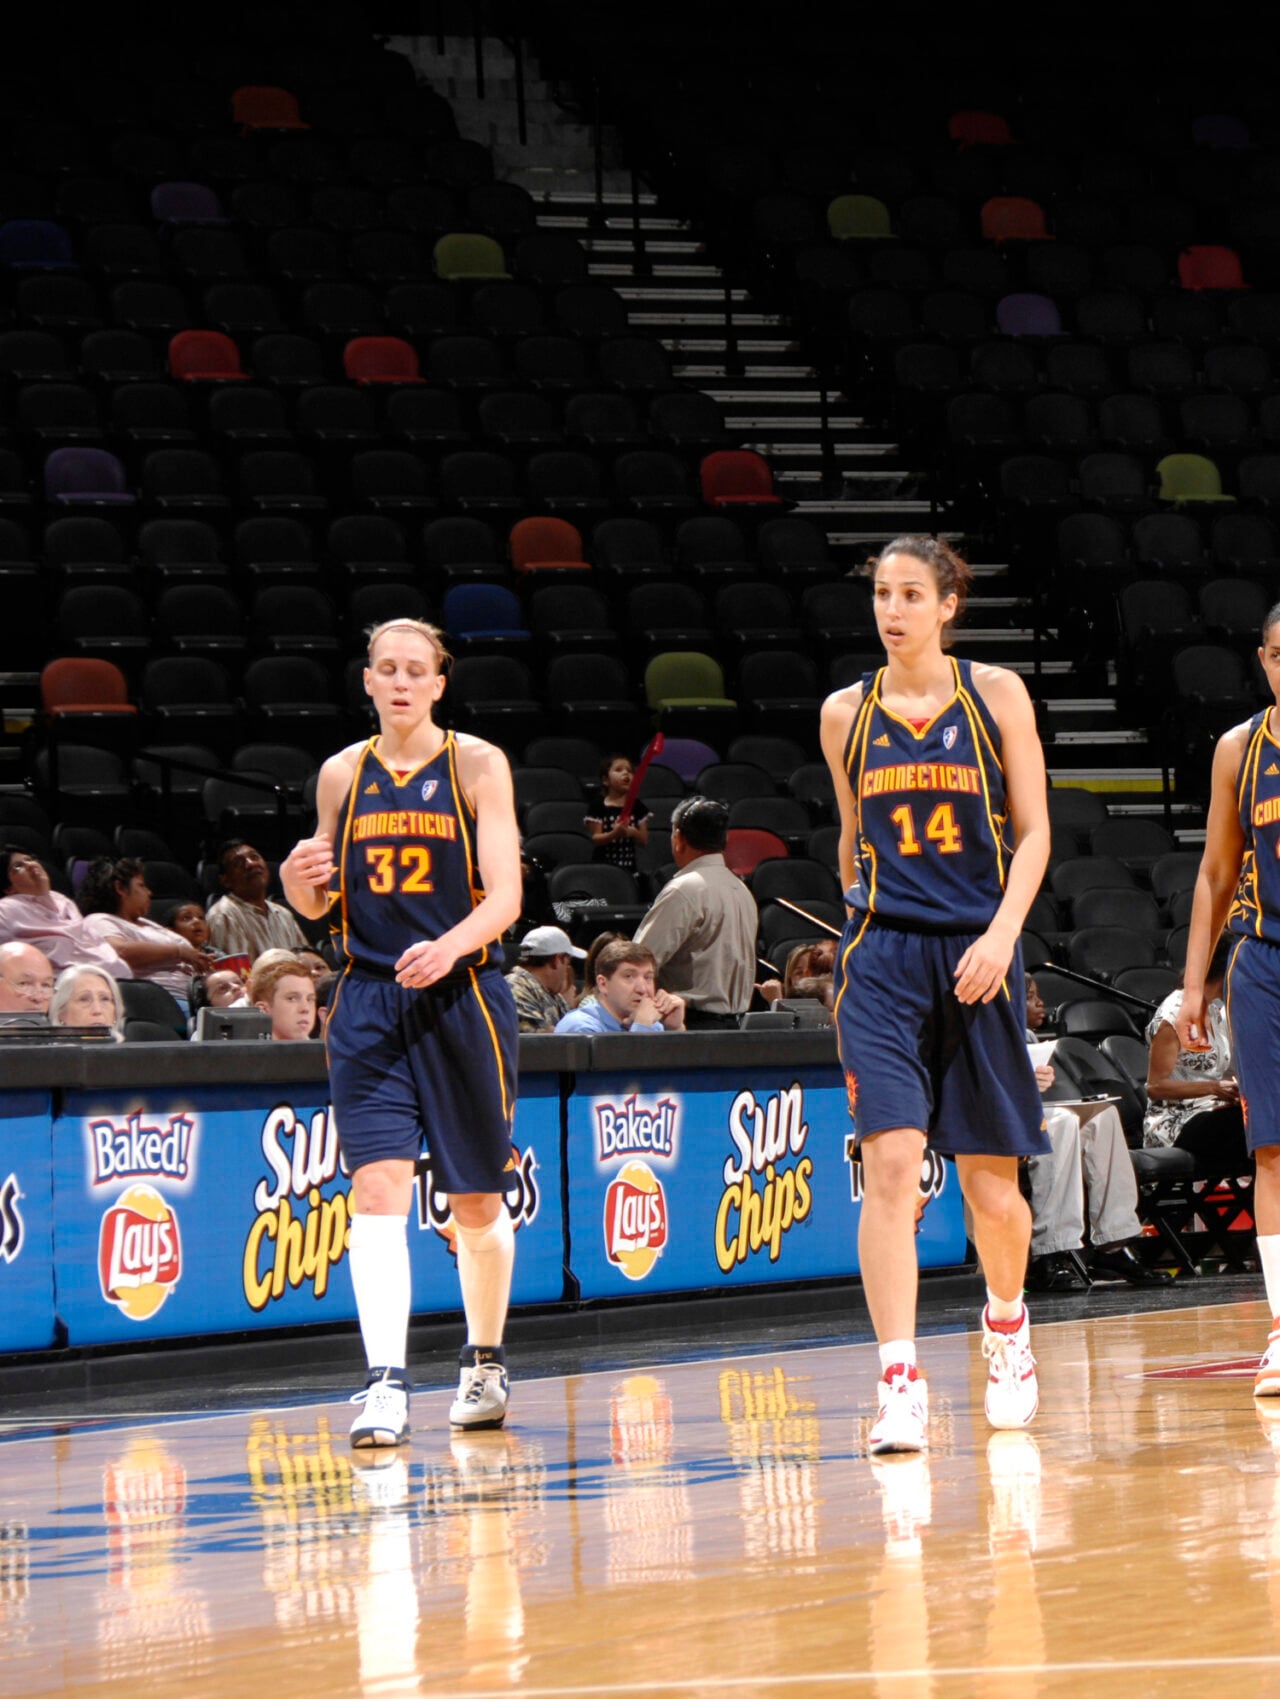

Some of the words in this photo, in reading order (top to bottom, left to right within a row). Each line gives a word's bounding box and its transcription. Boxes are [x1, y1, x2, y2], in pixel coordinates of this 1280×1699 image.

[862, 762, 981, 799] CONNECTICUT
[352, 810, 457, 843] CONNECTICUT
[890, 802, 963, 856] 14
[366, 844, 434, 895] 32
[91, 1110, 194, 1183] Baked!
[598, 1097, 677, 1160] Baked!
[724, 1081, 809, 1188] Sun
[242, 1187, 355, 1312] Chip
[610, 1185, 662, 1254] Lay's
[714, 1156, 813, 1274] Chips
[108, 1211, 174, 1292] Lay's
